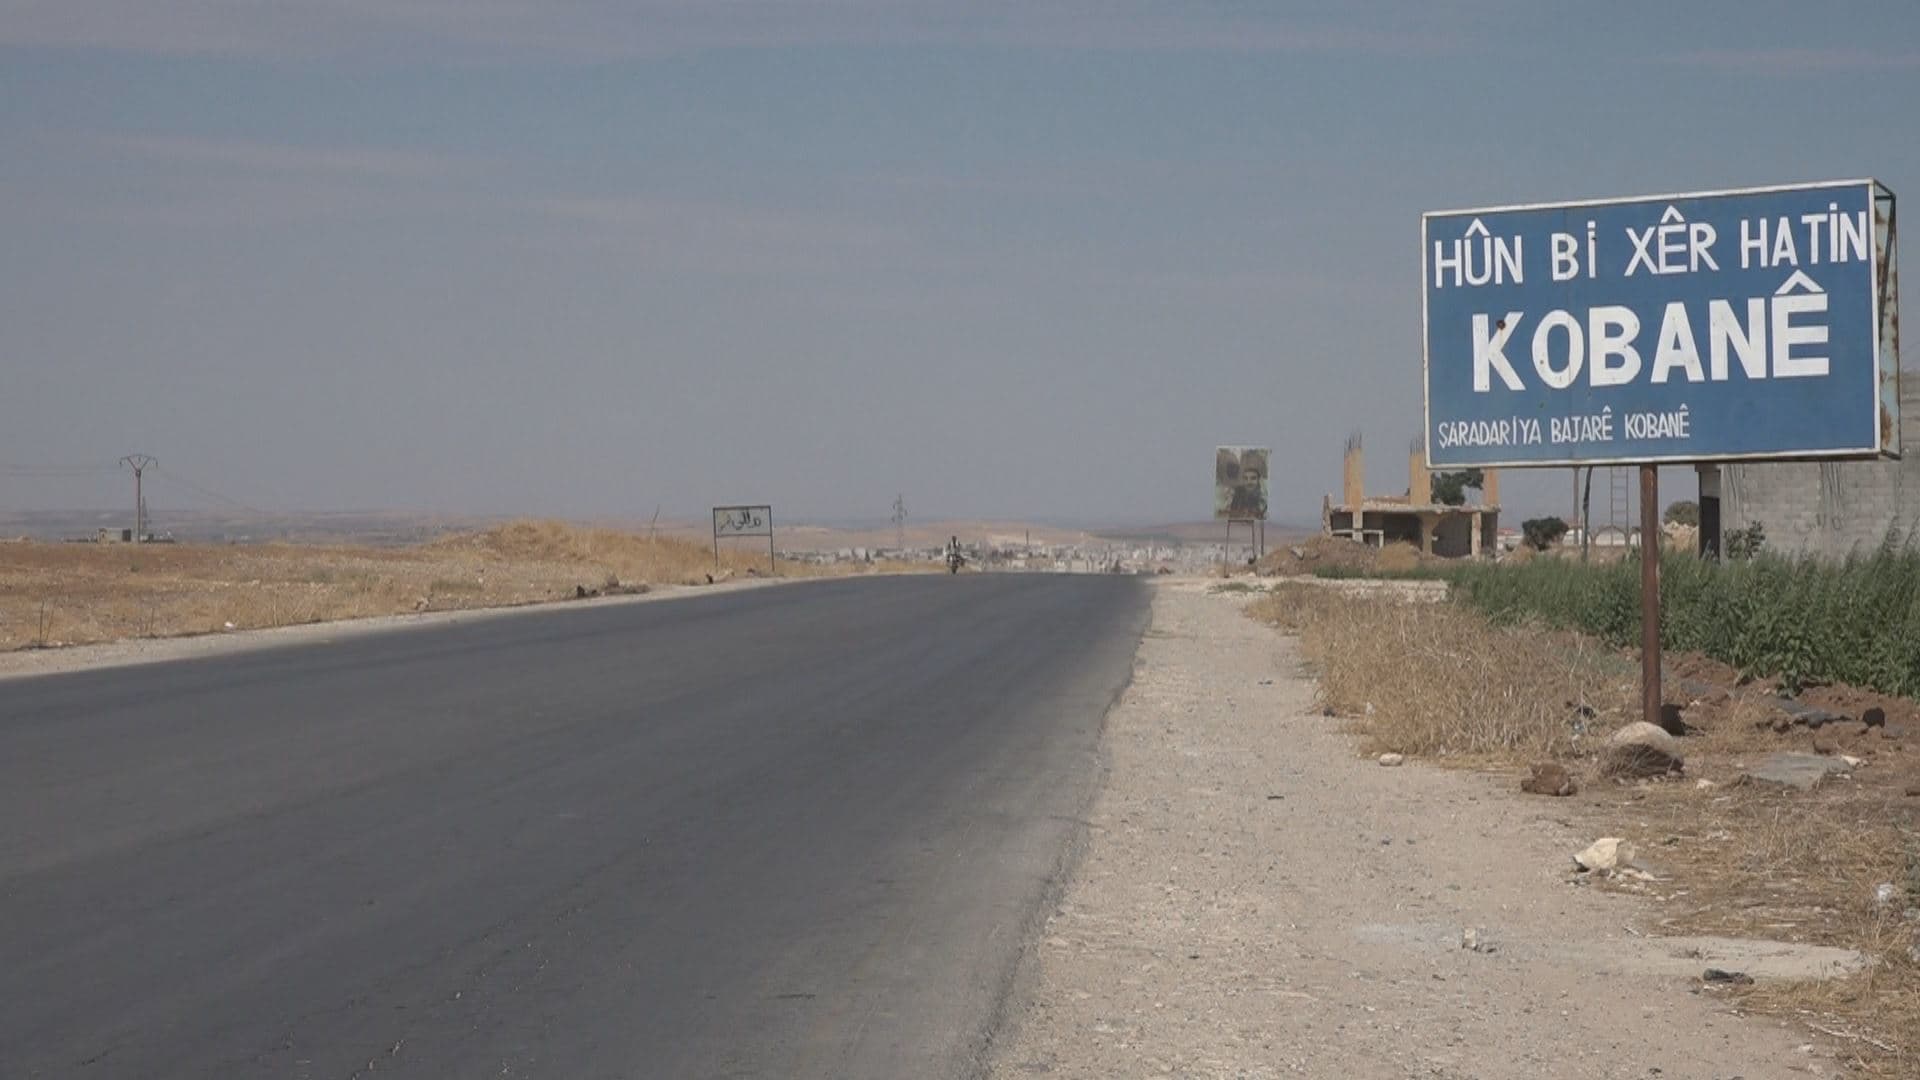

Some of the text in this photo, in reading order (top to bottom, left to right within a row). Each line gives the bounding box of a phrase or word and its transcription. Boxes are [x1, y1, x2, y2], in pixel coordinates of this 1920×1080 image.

[1435, 218, 1523, 288] HÛN
[1624, 205, 1720, 276] XÊR
[1472, 270, 1829, 393] KOBANÊ
[1551, 406, 1613, 443] BAJARÊ
[1624, 403, 1690, 440] KOBANÊ
